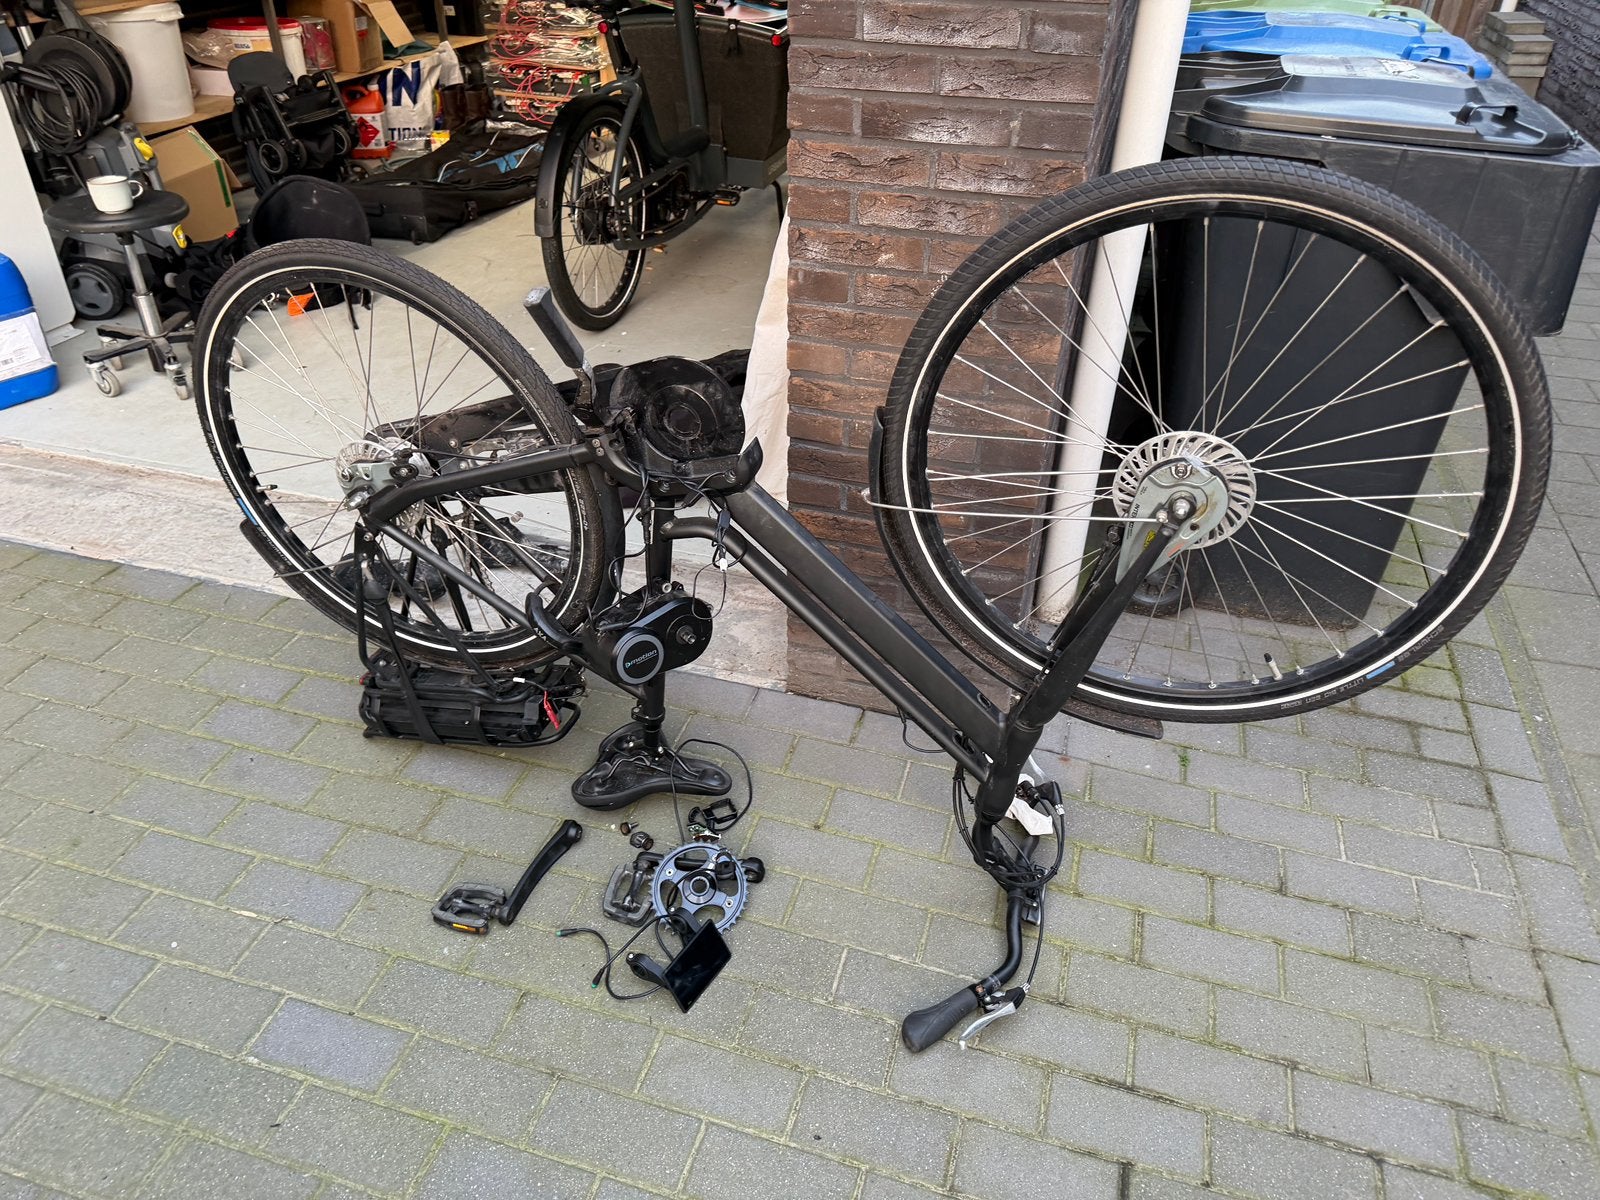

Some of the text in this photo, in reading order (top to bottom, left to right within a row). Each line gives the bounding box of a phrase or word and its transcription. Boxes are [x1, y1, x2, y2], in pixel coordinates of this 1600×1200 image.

[533, 627, 546, 642] AXA
[1397, 624, 1445, 662] SCHWALBE
[1340, 678, 1364, 692] LITTLE
